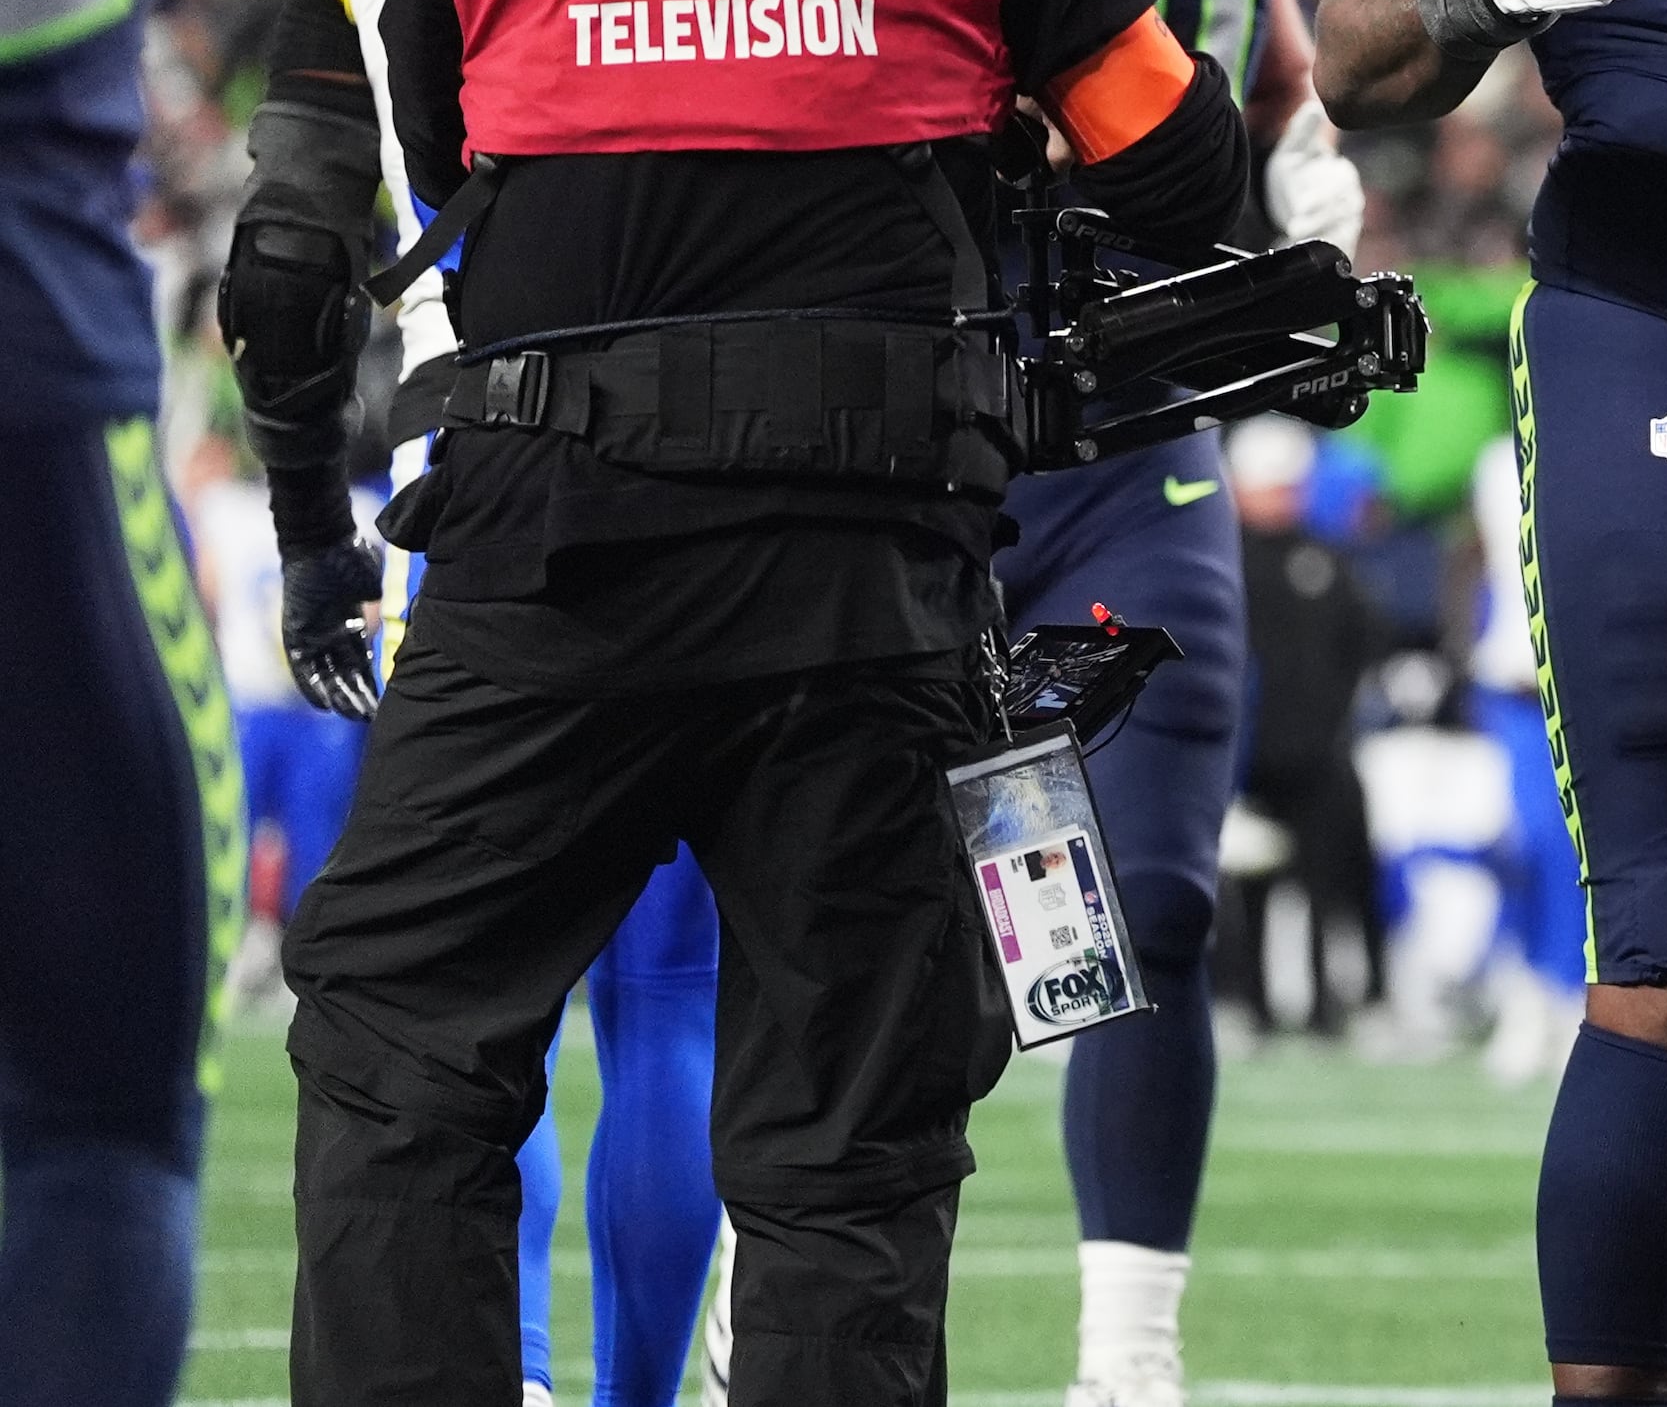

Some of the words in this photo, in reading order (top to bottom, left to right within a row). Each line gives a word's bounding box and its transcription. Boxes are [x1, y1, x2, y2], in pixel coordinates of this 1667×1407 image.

[1292, 369, 1349, 400] PRO
[1086, 907, 1108, 958] SEASON
[1044, 966, 1104, 1006] FOX
